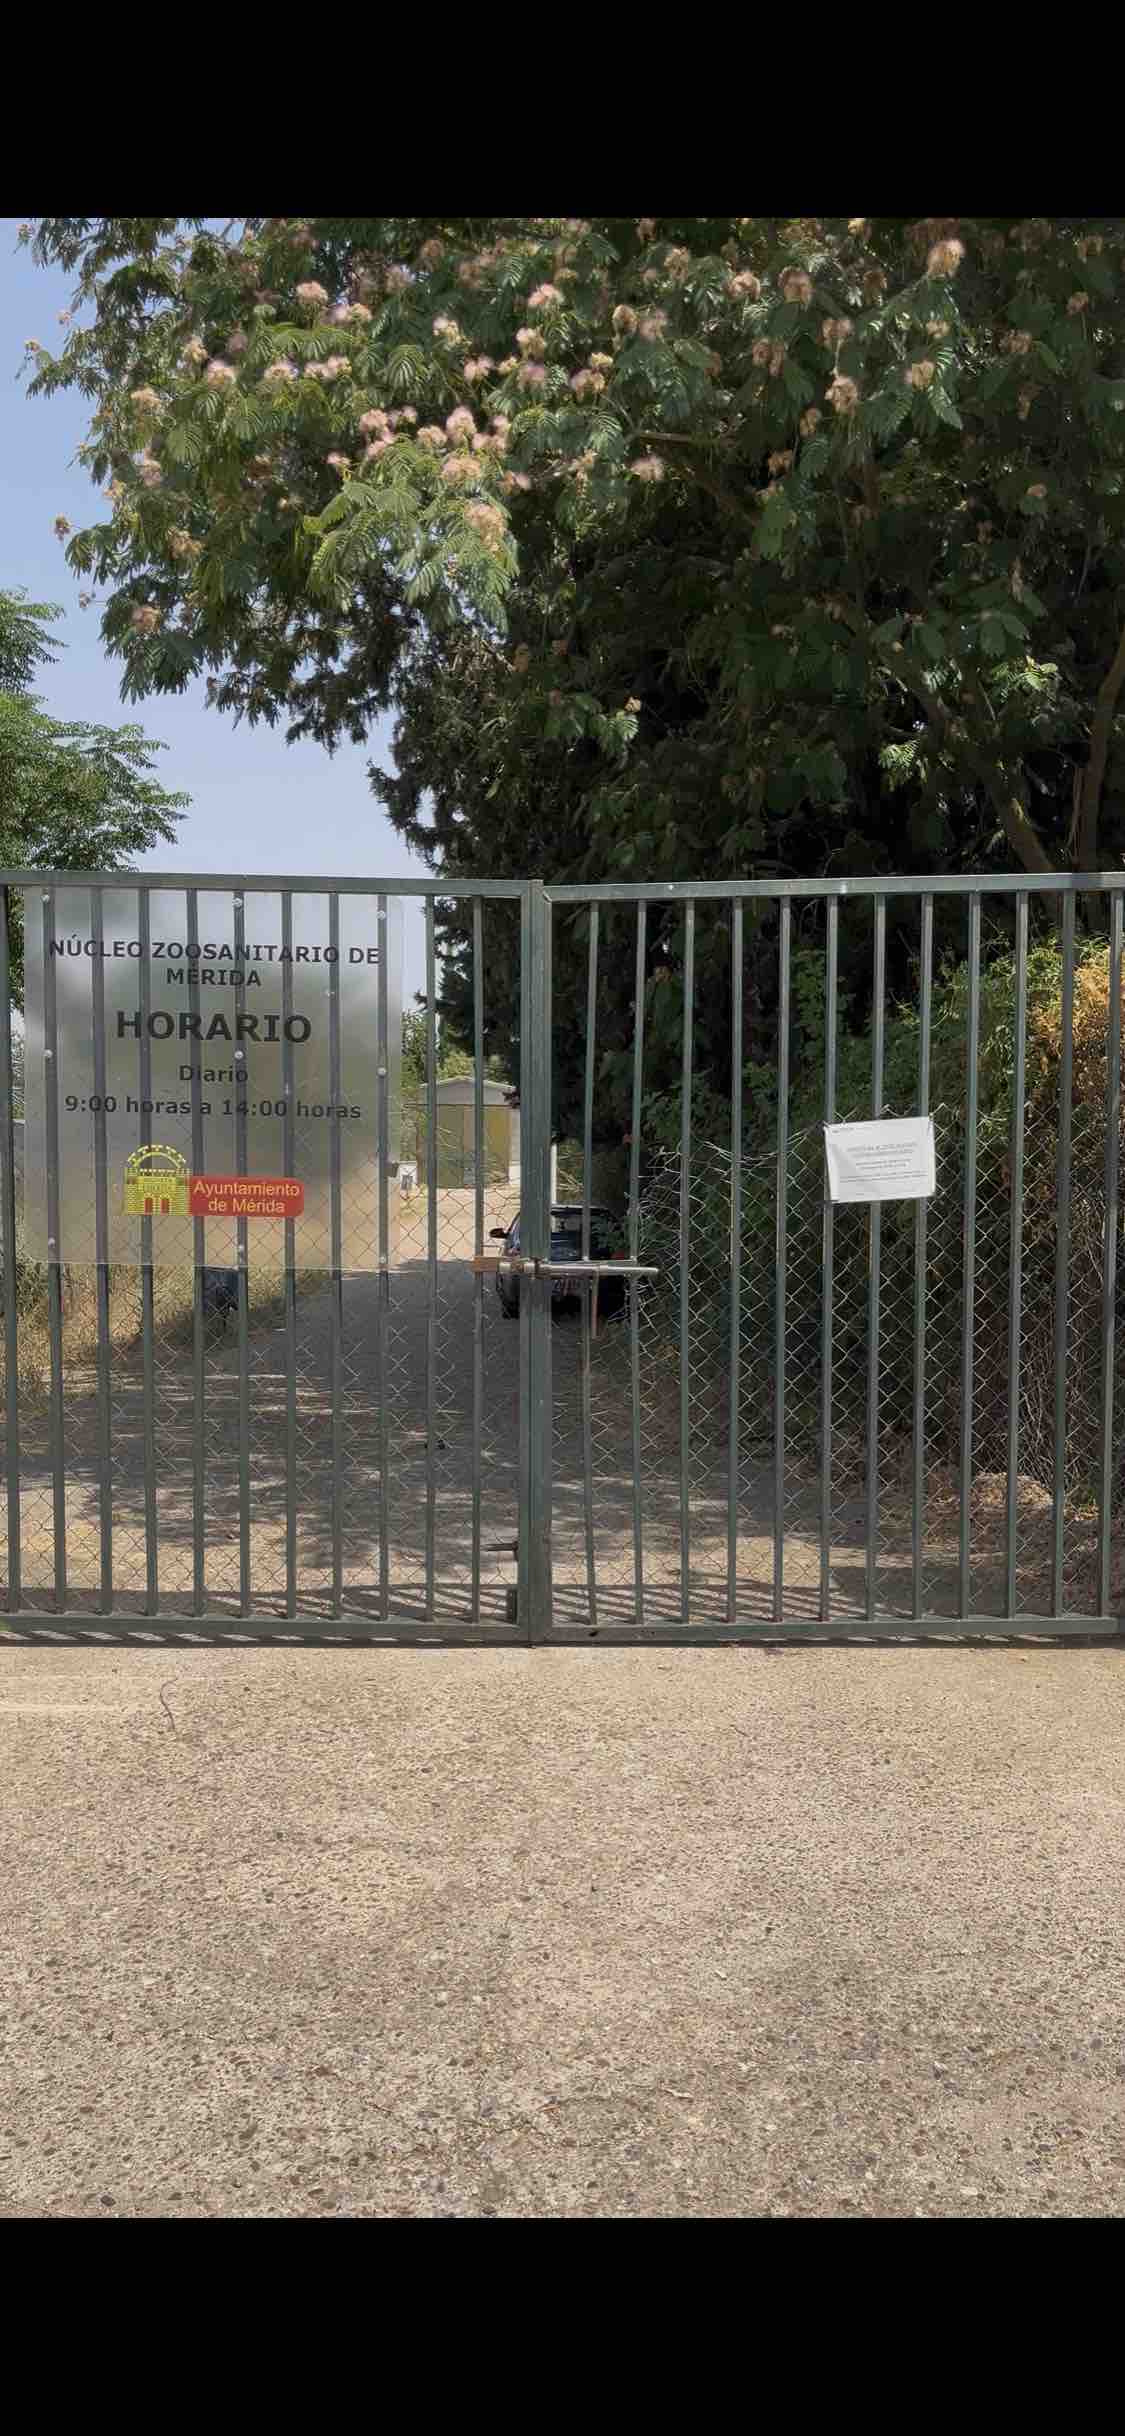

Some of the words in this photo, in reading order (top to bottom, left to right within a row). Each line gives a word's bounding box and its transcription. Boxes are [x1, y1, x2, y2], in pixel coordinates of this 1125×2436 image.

[49, 936, 143, 959] NÚCLEO
[151, 941, 339, 963] ZOOSANITARIO
[347, 945, 381, 963] DE
[166, 962, 262, 987] MÉRIDA
[117, 1011, 312, 1043] HORARIO
[178, 1064, 249, 1083] Diario
[64, 1095, 117, 1114] 9:00
[126, 1096, 191, 1116] horas
[199, 1102, 212, 1115] a
[223, 1099, 288, 1117] 14:00
[296, 1100, 362, 1118] horas
[193, 1182, 300, 1200] Ayuntamiento
[208, 1197, 227, 1212] de
[231, 1197, 286, 1213] Mérida
